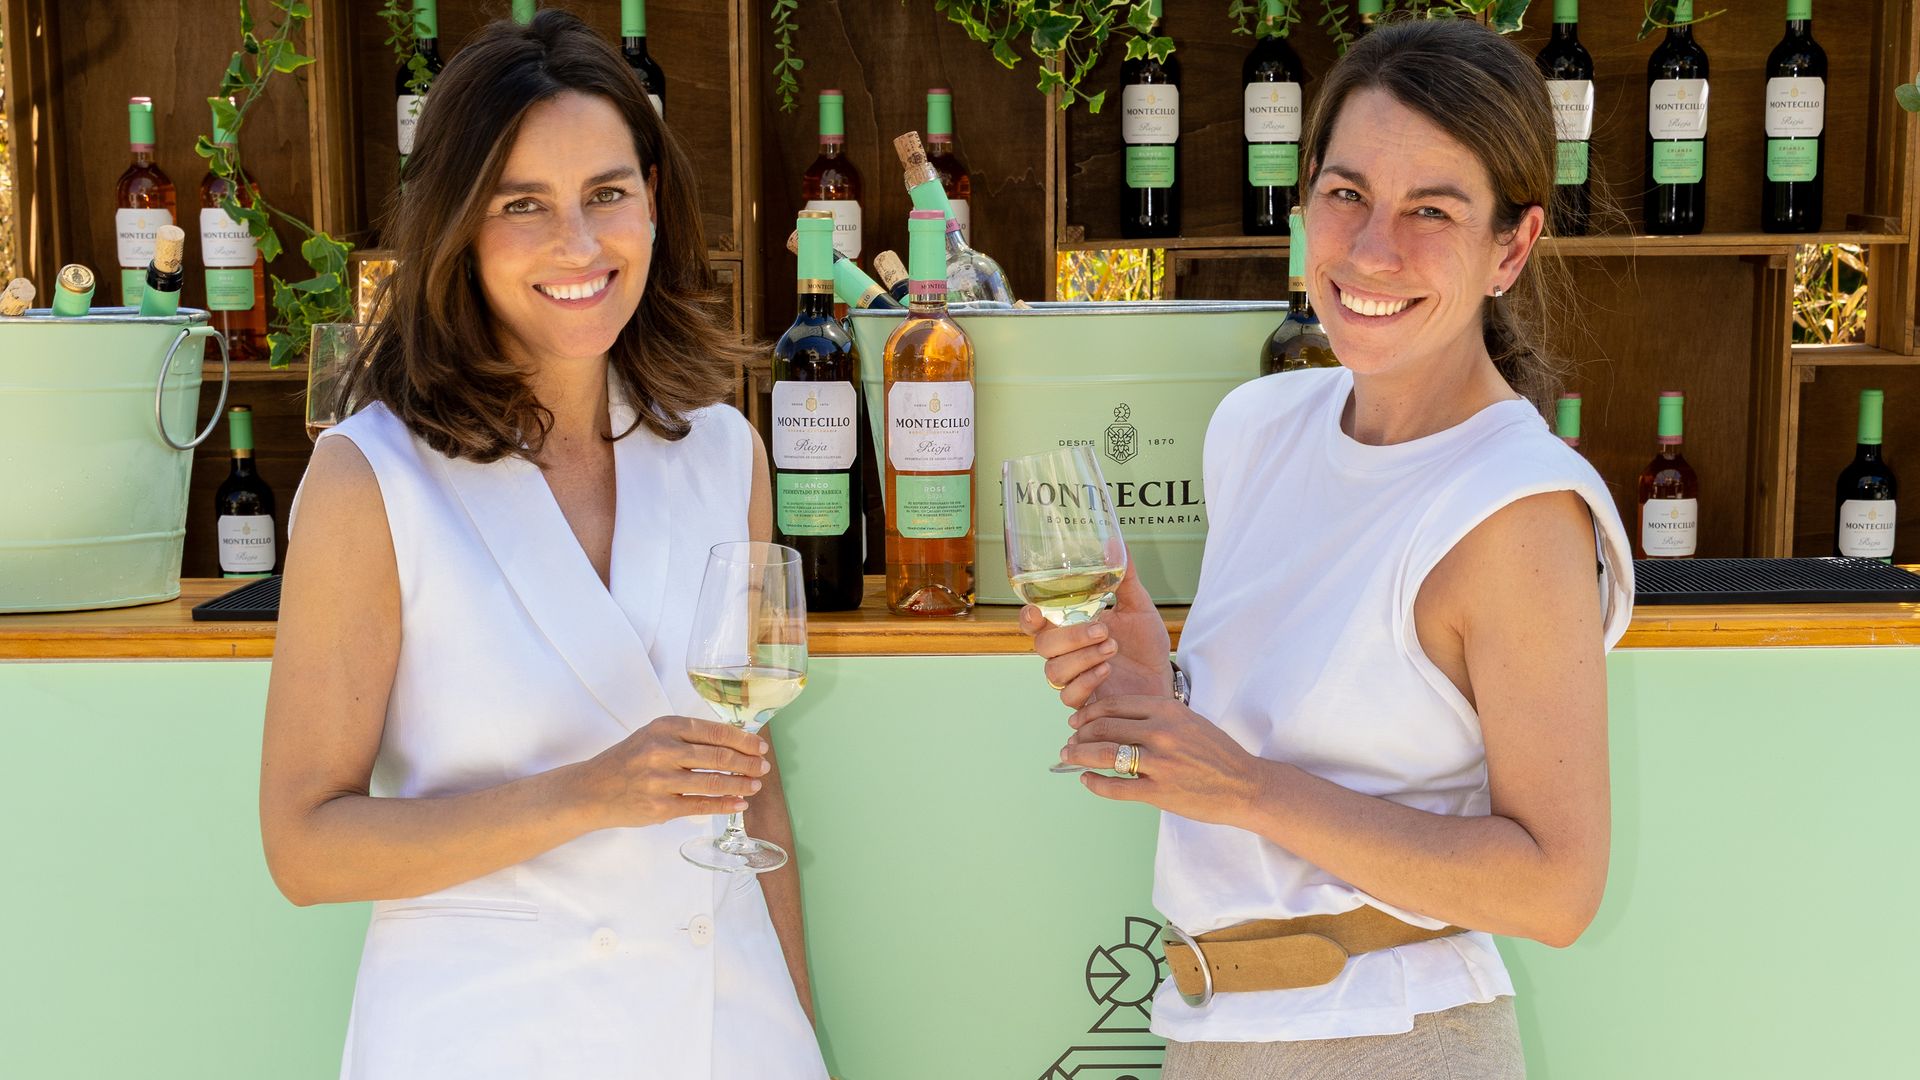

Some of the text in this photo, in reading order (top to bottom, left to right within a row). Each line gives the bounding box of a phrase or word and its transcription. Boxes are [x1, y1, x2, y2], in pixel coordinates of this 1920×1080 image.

[1249, 105, 1299, 114] MONTECILLO
[777, 416, 851, 427] MONTECILLO
[895, 417, 970, 428] MONTECILLO
[794, 439, 829, 454] Rioja
[916, 440, 952, 455] Rioja
[1058, 438, 1175, 448] DESDE 1870
[1046, 515, 1095, 526] BODEGA
[1648, 521, 1696, 529] MONTECILLO
[1846, 522, 1894, 530] MONTECILLO
[223, 537, 272, 545] MONTECILLO
